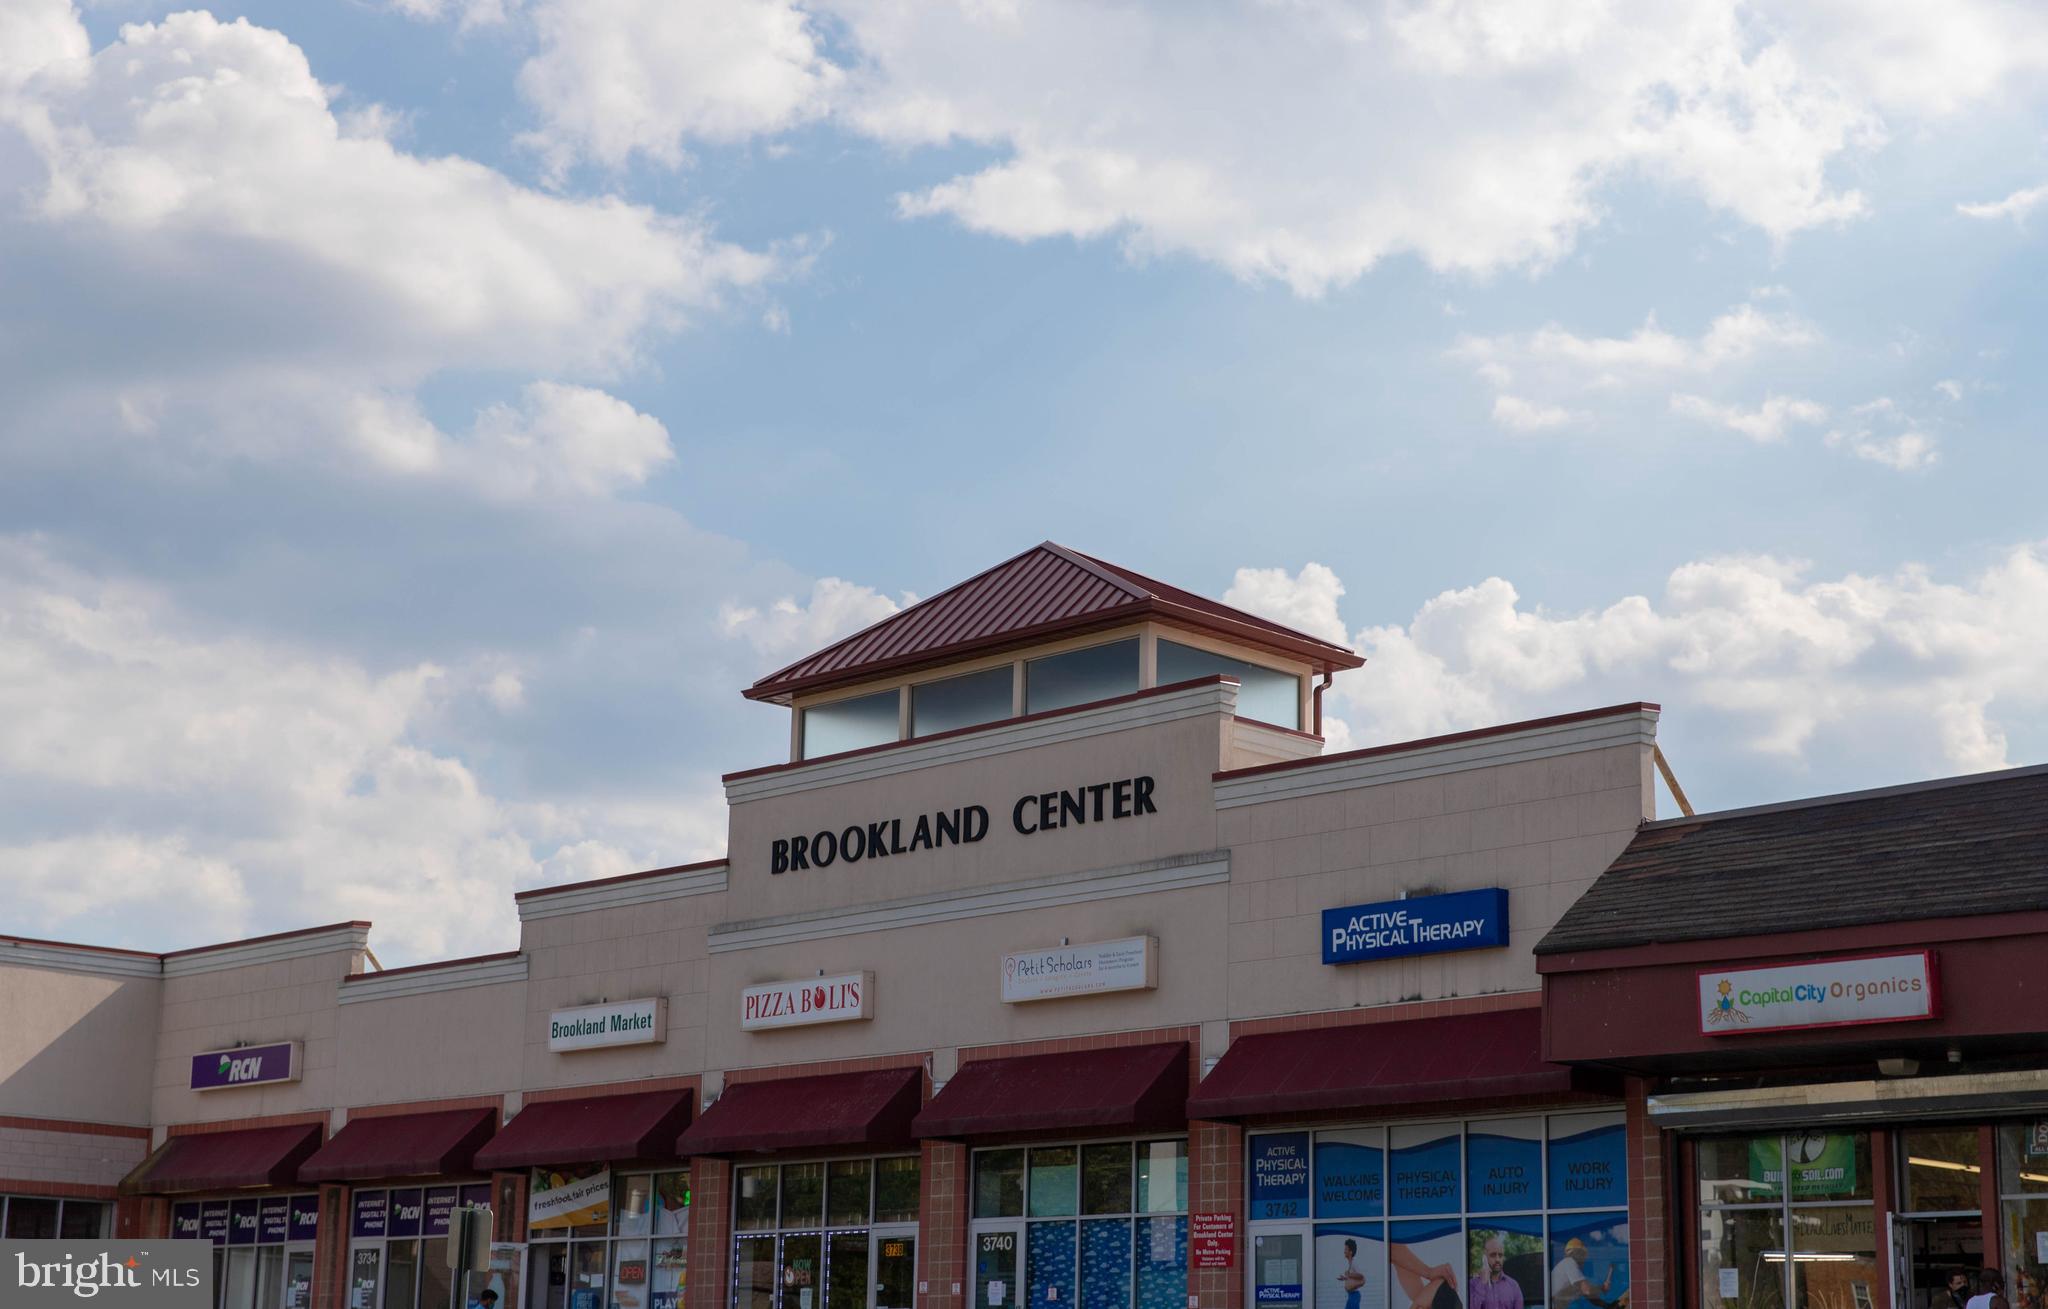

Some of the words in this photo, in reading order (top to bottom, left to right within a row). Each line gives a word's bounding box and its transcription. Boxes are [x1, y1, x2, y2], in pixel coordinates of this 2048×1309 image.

[771, 804, 989, 875] BROOKLAND
[1012, 775, 1158, 836] CENTER
[1347, 910, 1407, 933] ACTIVE
[1332, 927, 1409, 953] PHYSICAL
[1408, 918, 1485, 944] THERAPY
[1830, 976, 1922, 1002] Organics
[745, 990, 796, 1020] PIZZA
[551, 1016, 606, 1039] Brookland
[610, 1012, 653, 1032] Market
[227, 1056, 263, 1082] RCN
[1266, 1146, 1296, 1156] ACTIVE
[1256, 1158, 1308, 1172] PHYSICAL
[1567, 1161, 1611, 1175] WORK
[1256, 1172, 1306, 1187] THERAPY
[1396, 1169, 1457, 1185] PHYSICAL
[1489, 1166, 1524, 1180] AUTO
[1323, 1174, 1379, 1187] WALK-INS
[1565, 1177, 1614, 1192] INJURY
[585, 1182, 609, 1197] prices
[1322, 1188, 1381, 1202] WELCOME
[1398, 1185, 1456, 1200] THERAPY
[1483, 1181, 1529, 1196] INJURY
[358, 1200, 385, 1208] INTERNET
[427, 1196, 456, 1205] INTERNET
[262, 1206, 287, 1214] INTERNET
[400, 1206, 421, 1220] RCN
[1265, 1201, 1297, 1217] 3742
[182, 1219, 200, 1231] RCN
[240, 1215, 258, 1228] RCN
[298, 1212, 318, 1225] RCN
[364, 1220, 384, 1229] PHONE
[433, 1218, 450, 1226] PHON
[983, 1235, 1013, 1251] 3740
[357, 1252, 377, 1265] 3734
[621, 1265, 644, 1280] OPEN
[654, 1297, 678, 1309] PLAY
